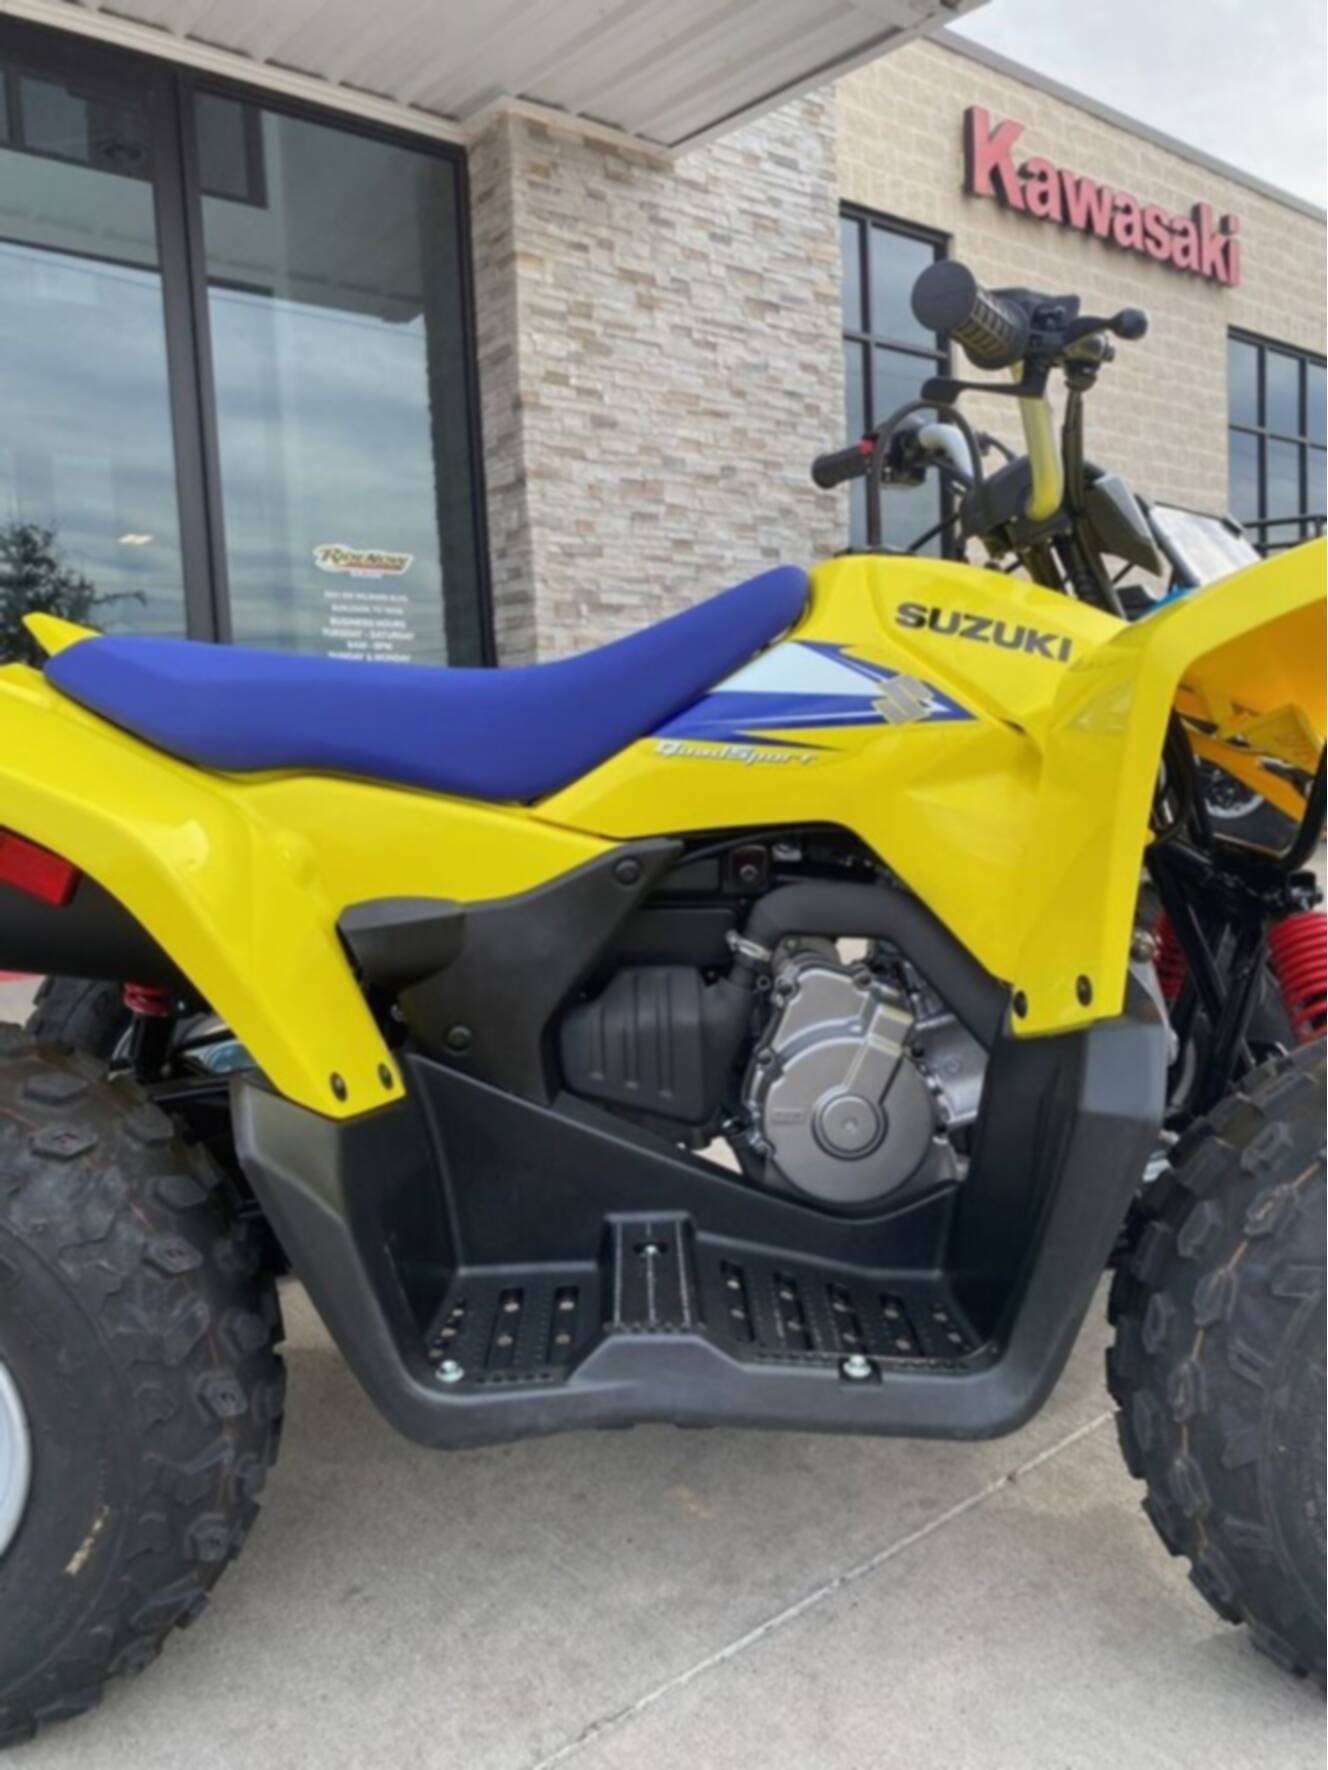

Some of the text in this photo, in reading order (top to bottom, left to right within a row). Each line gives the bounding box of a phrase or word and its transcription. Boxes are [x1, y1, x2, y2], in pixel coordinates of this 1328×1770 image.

[965, 105, 1240, 286] Kawasaki
[895, 602, 1072, 662] SUZUKI
[654, 738, 817, 766] QuadSport
